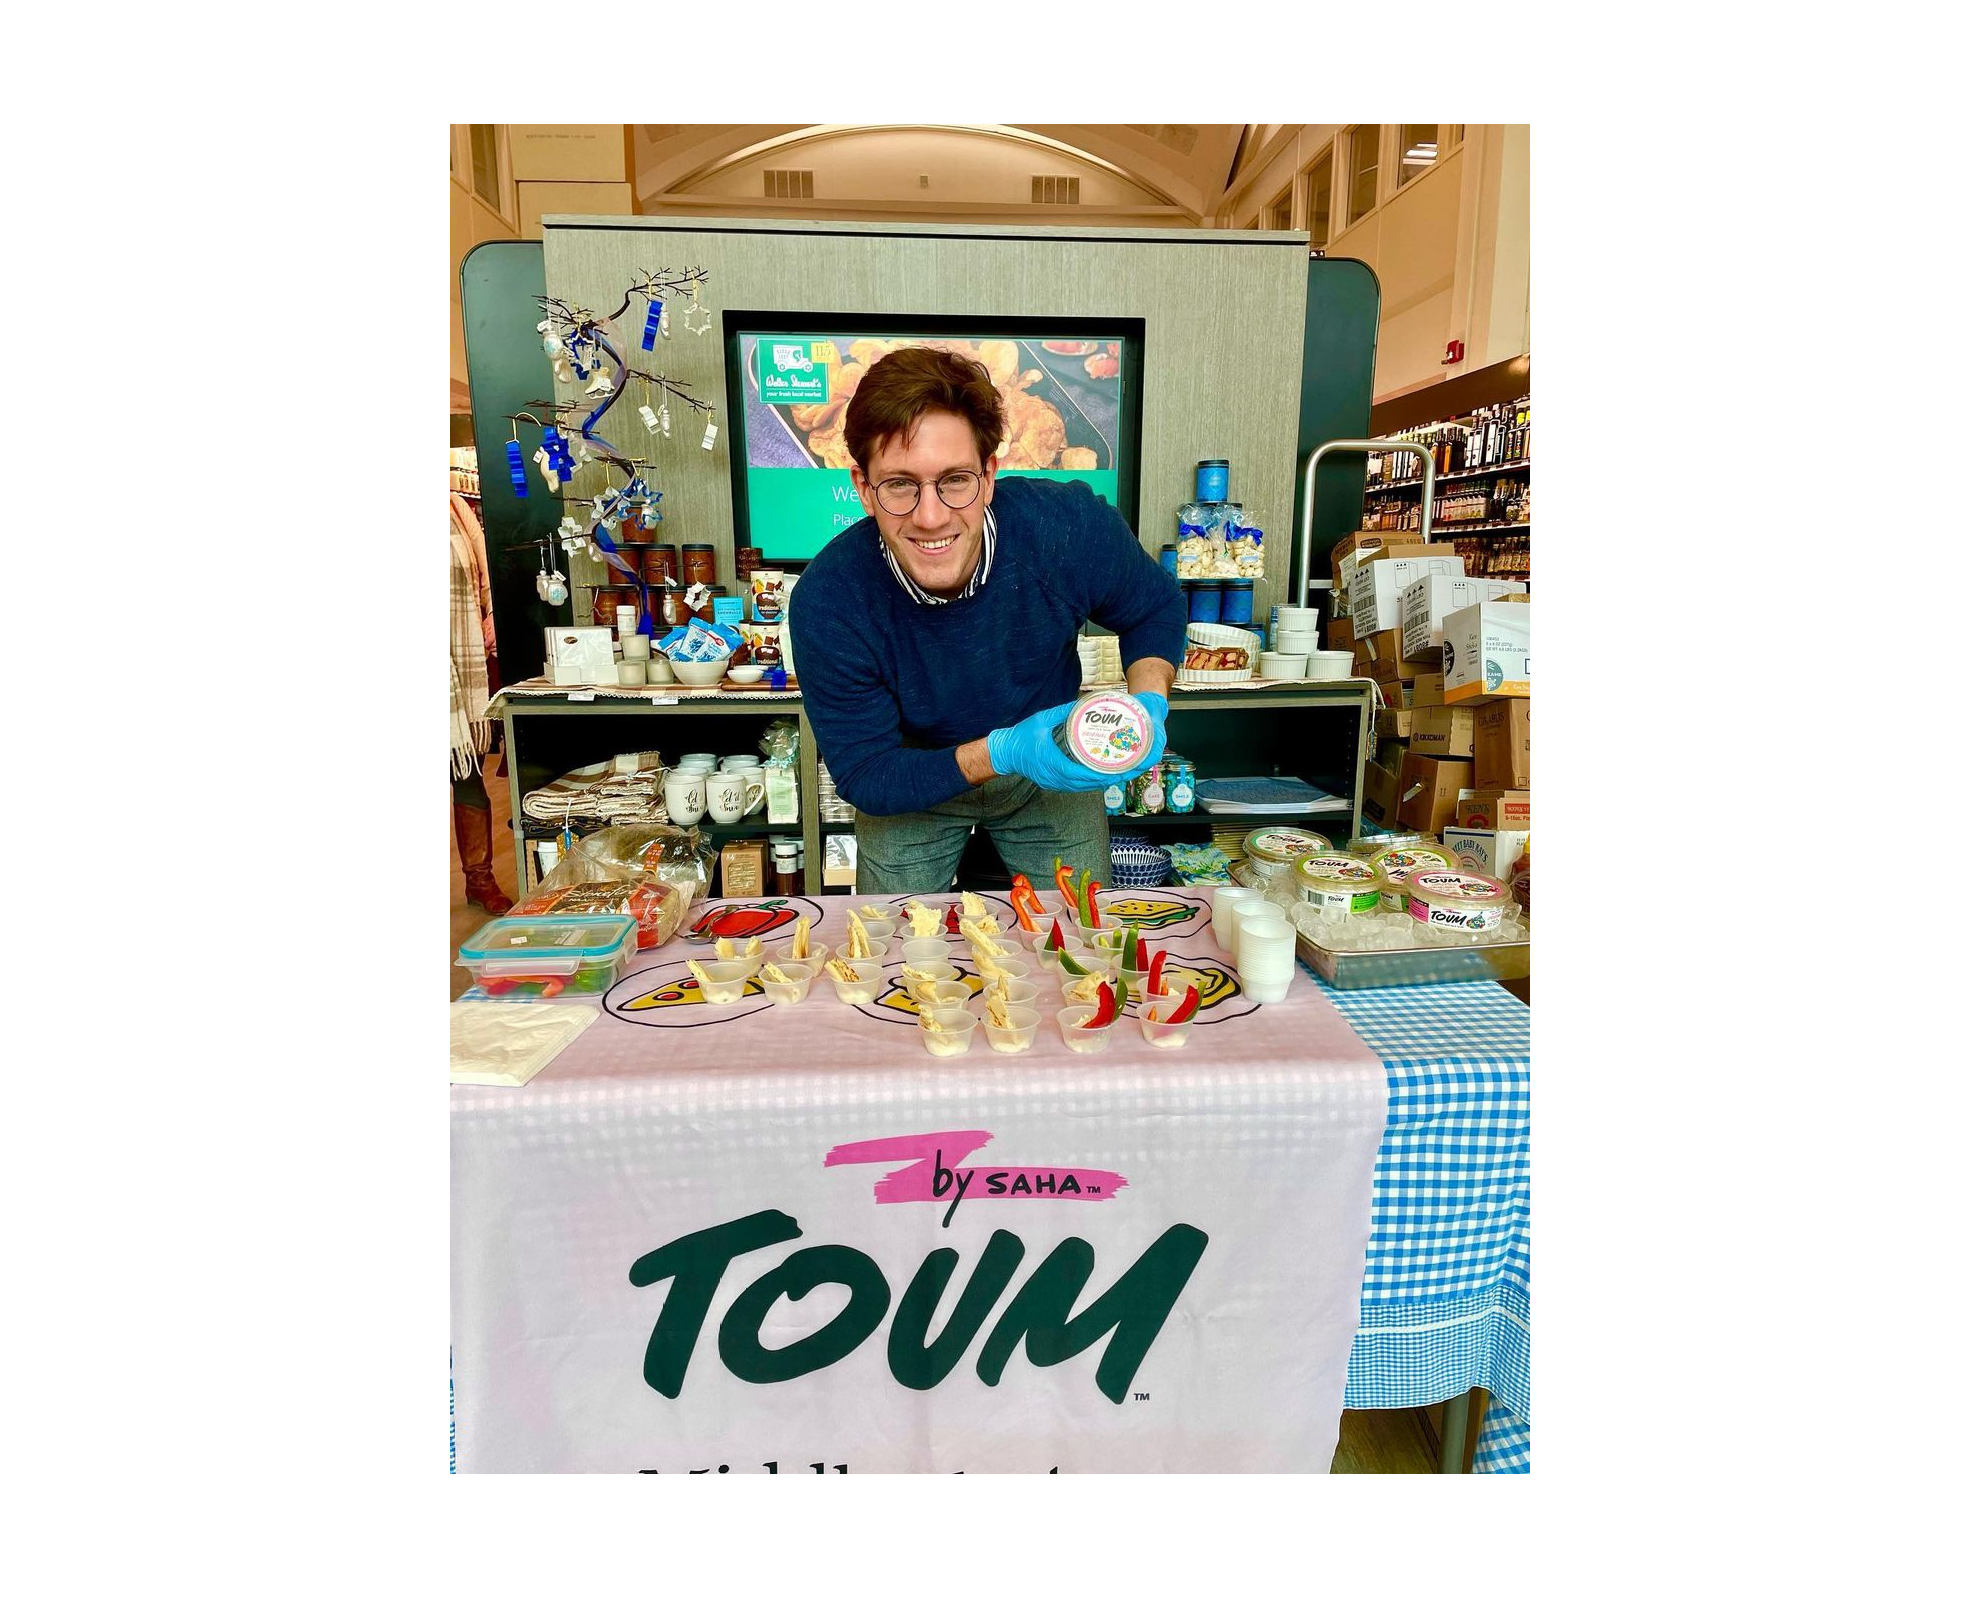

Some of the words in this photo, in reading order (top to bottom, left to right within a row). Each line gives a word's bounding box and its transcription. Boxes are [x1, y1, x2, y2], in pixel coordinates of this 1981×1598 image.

[1085, 710, 1123, 727] TOUM
[1266, 834, 1305, 844] TOUM
[1430, 910, 1467, 925] TOUM
[933, 1149, 974, 1228] by
[985, 1172, 1081, 1194] SAHA
[629, 1209, 1209, 1405] TOUM
